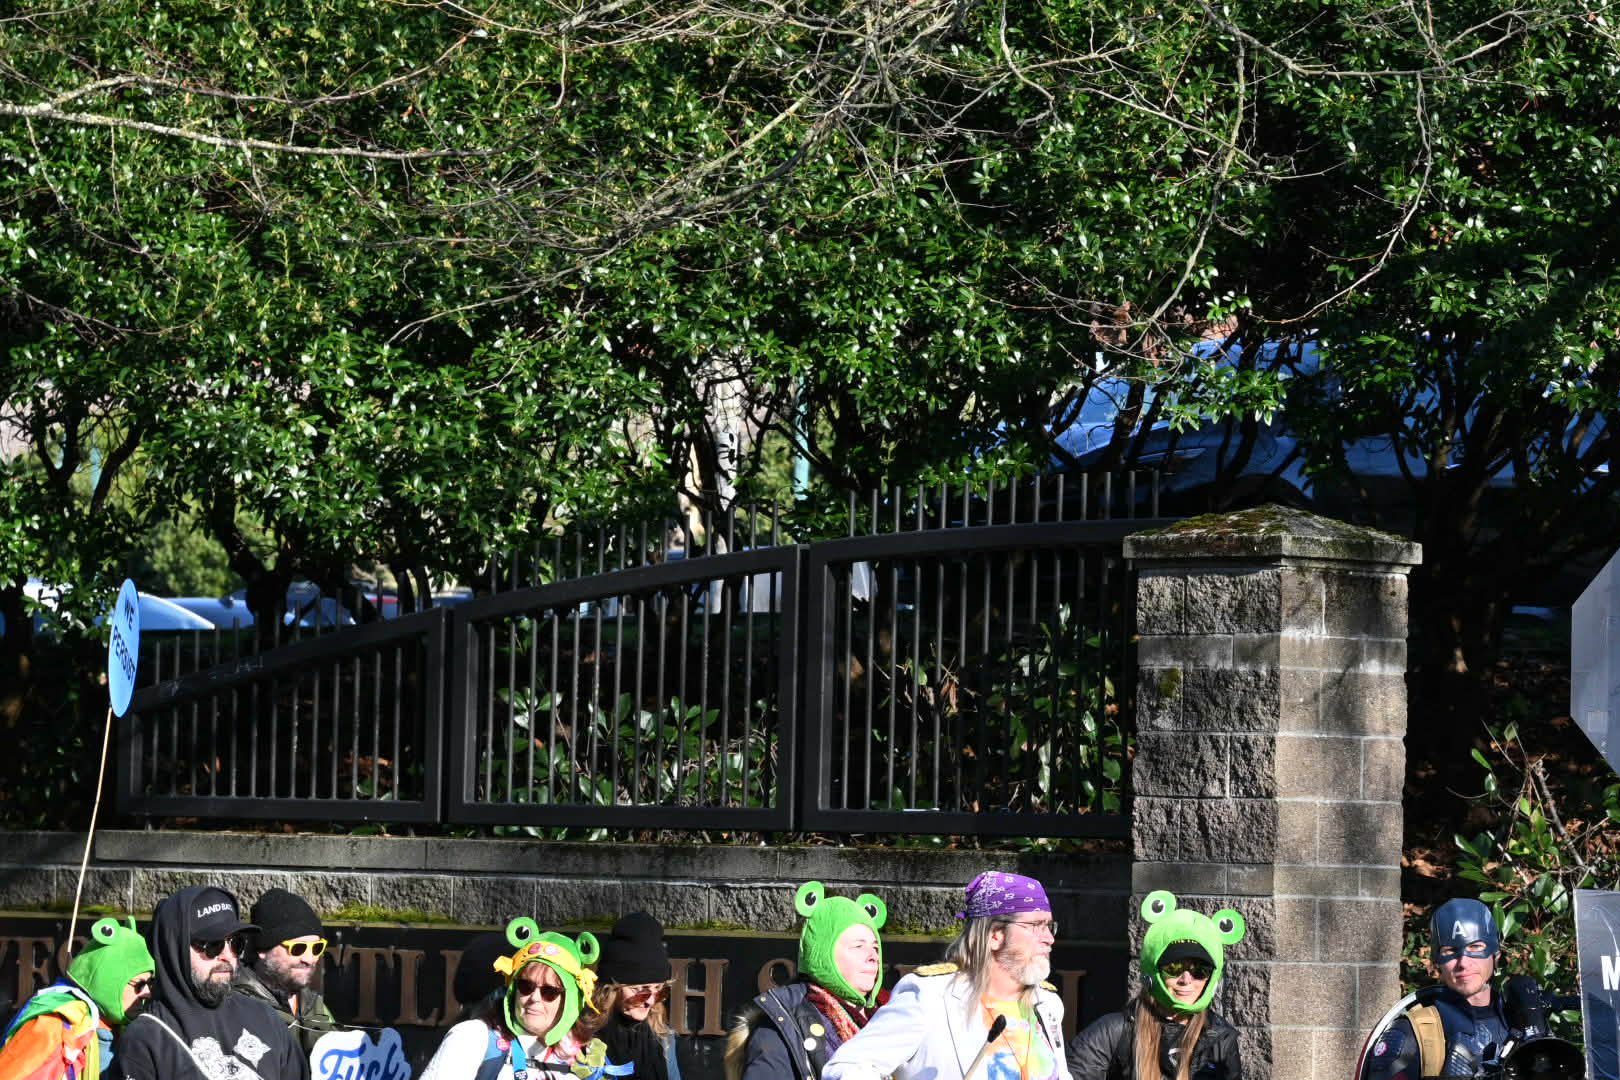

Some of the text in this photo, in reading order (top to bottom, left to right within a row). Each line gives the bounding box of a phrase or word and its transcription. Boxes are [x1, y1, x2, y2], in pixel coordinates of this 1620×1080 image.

[125, 596, 134, 631] WE
[112, 624, 135, 687] PERSIST
[197, 903, 221, 918] LAND
[1452, 920, 1467, 940] A
